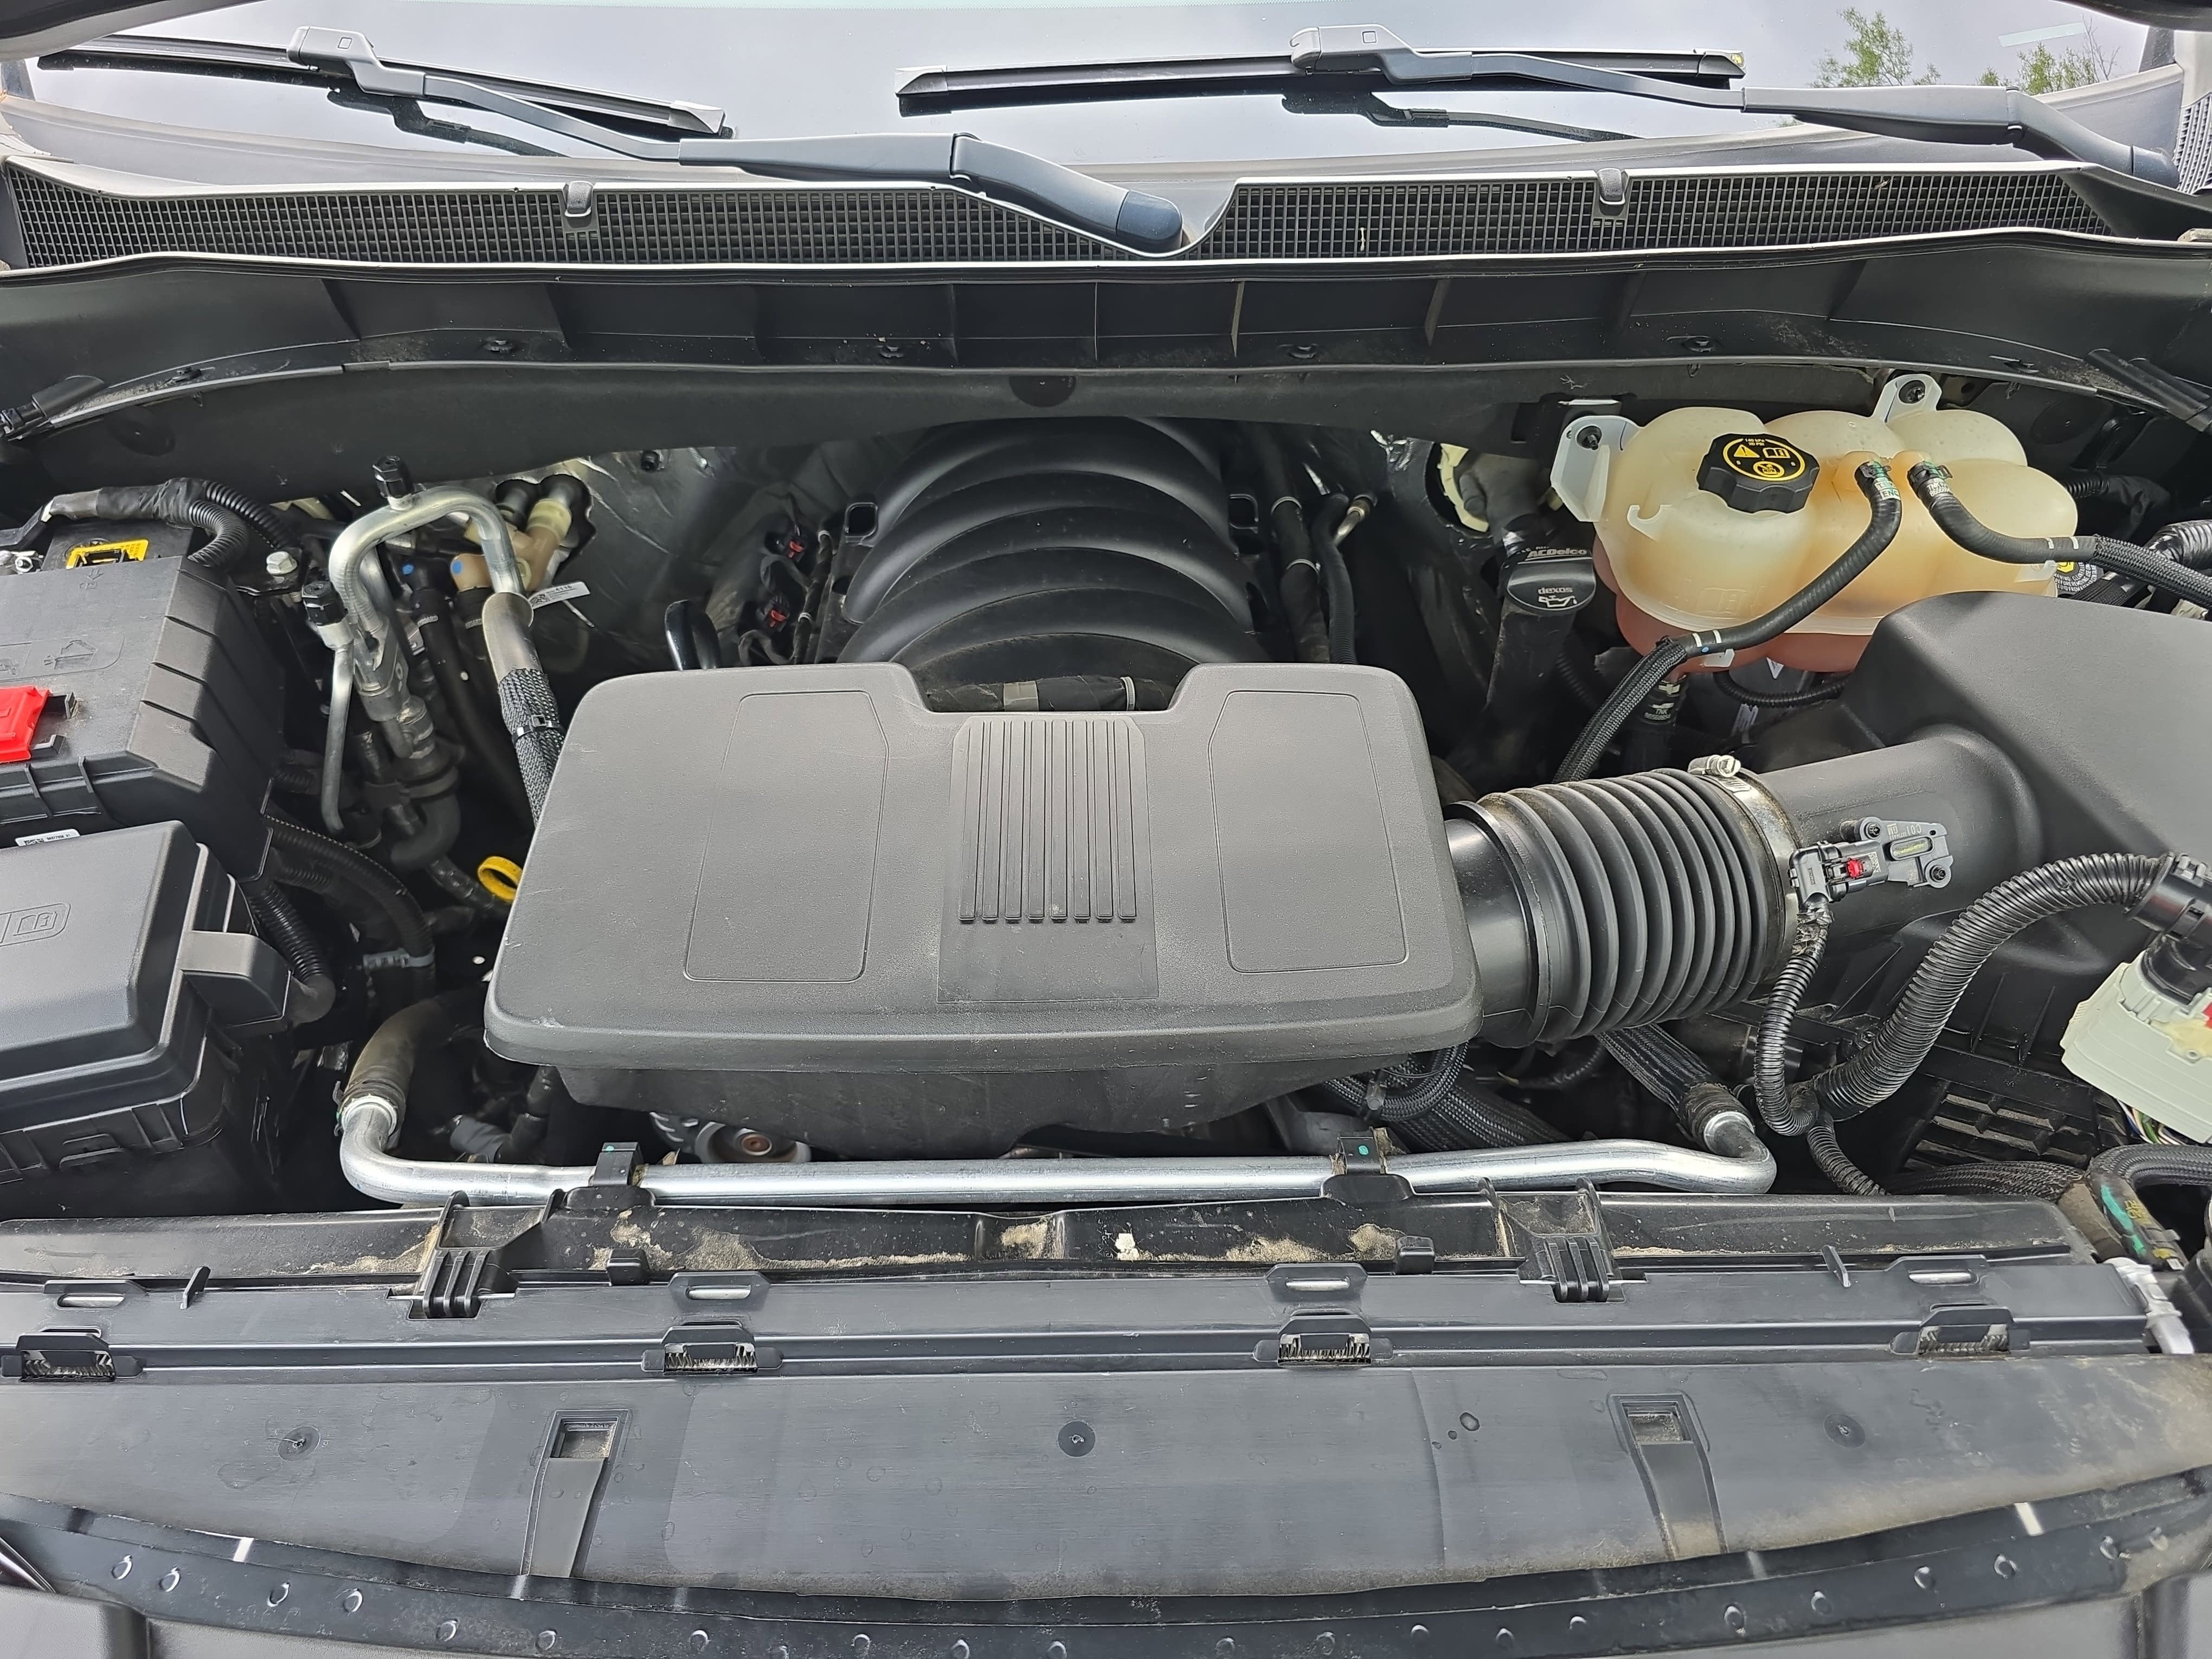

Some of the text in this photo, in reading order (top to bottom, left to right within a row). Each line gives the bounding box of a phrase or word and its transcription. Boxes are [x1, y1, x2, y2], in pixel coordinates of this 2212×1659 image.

[1527, 548, 1587, 558] ACDelco
[2053, 573, 2071, 582] ARNING
[1887, 825, 1898, 836] GM
